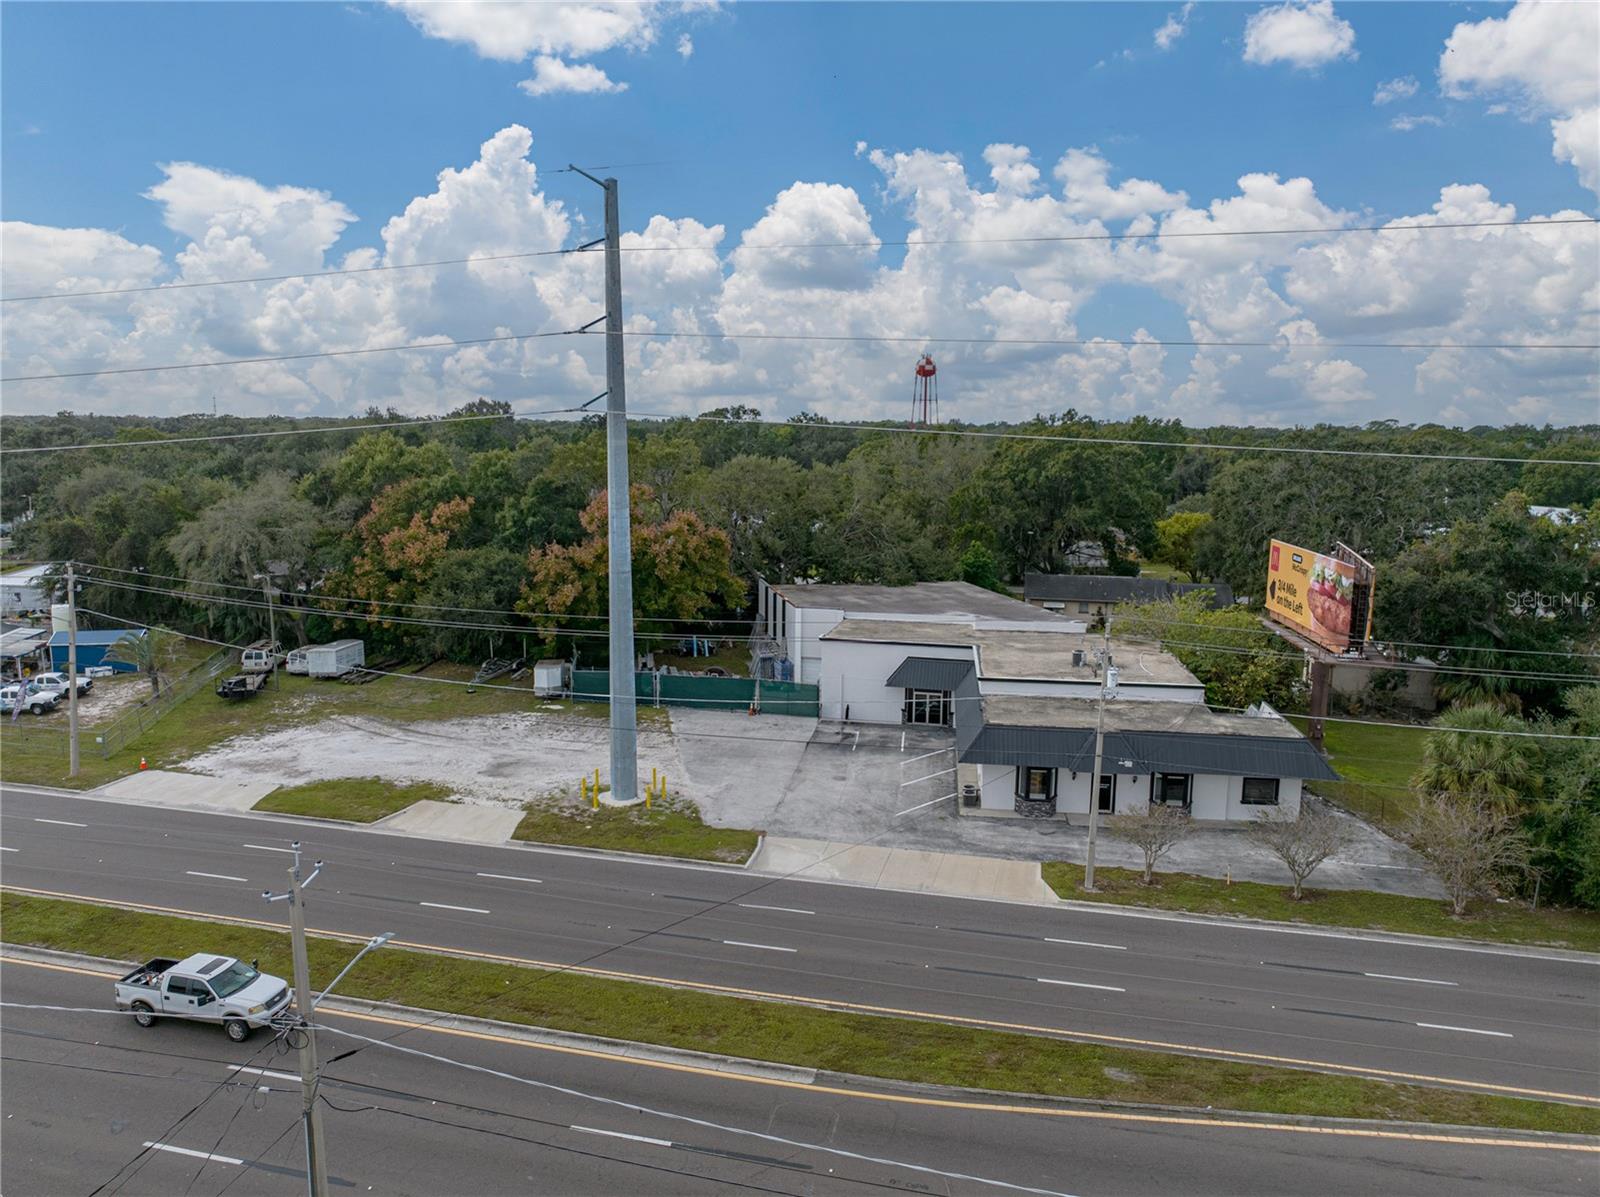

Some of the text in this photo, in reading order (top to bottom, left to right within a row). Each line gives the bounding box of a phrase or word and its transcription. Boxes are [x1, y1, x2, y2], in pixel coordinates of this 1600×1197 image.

[1286, 582, 1297, 597] Mile
[1276, 595, 1303, 616] on the Left
